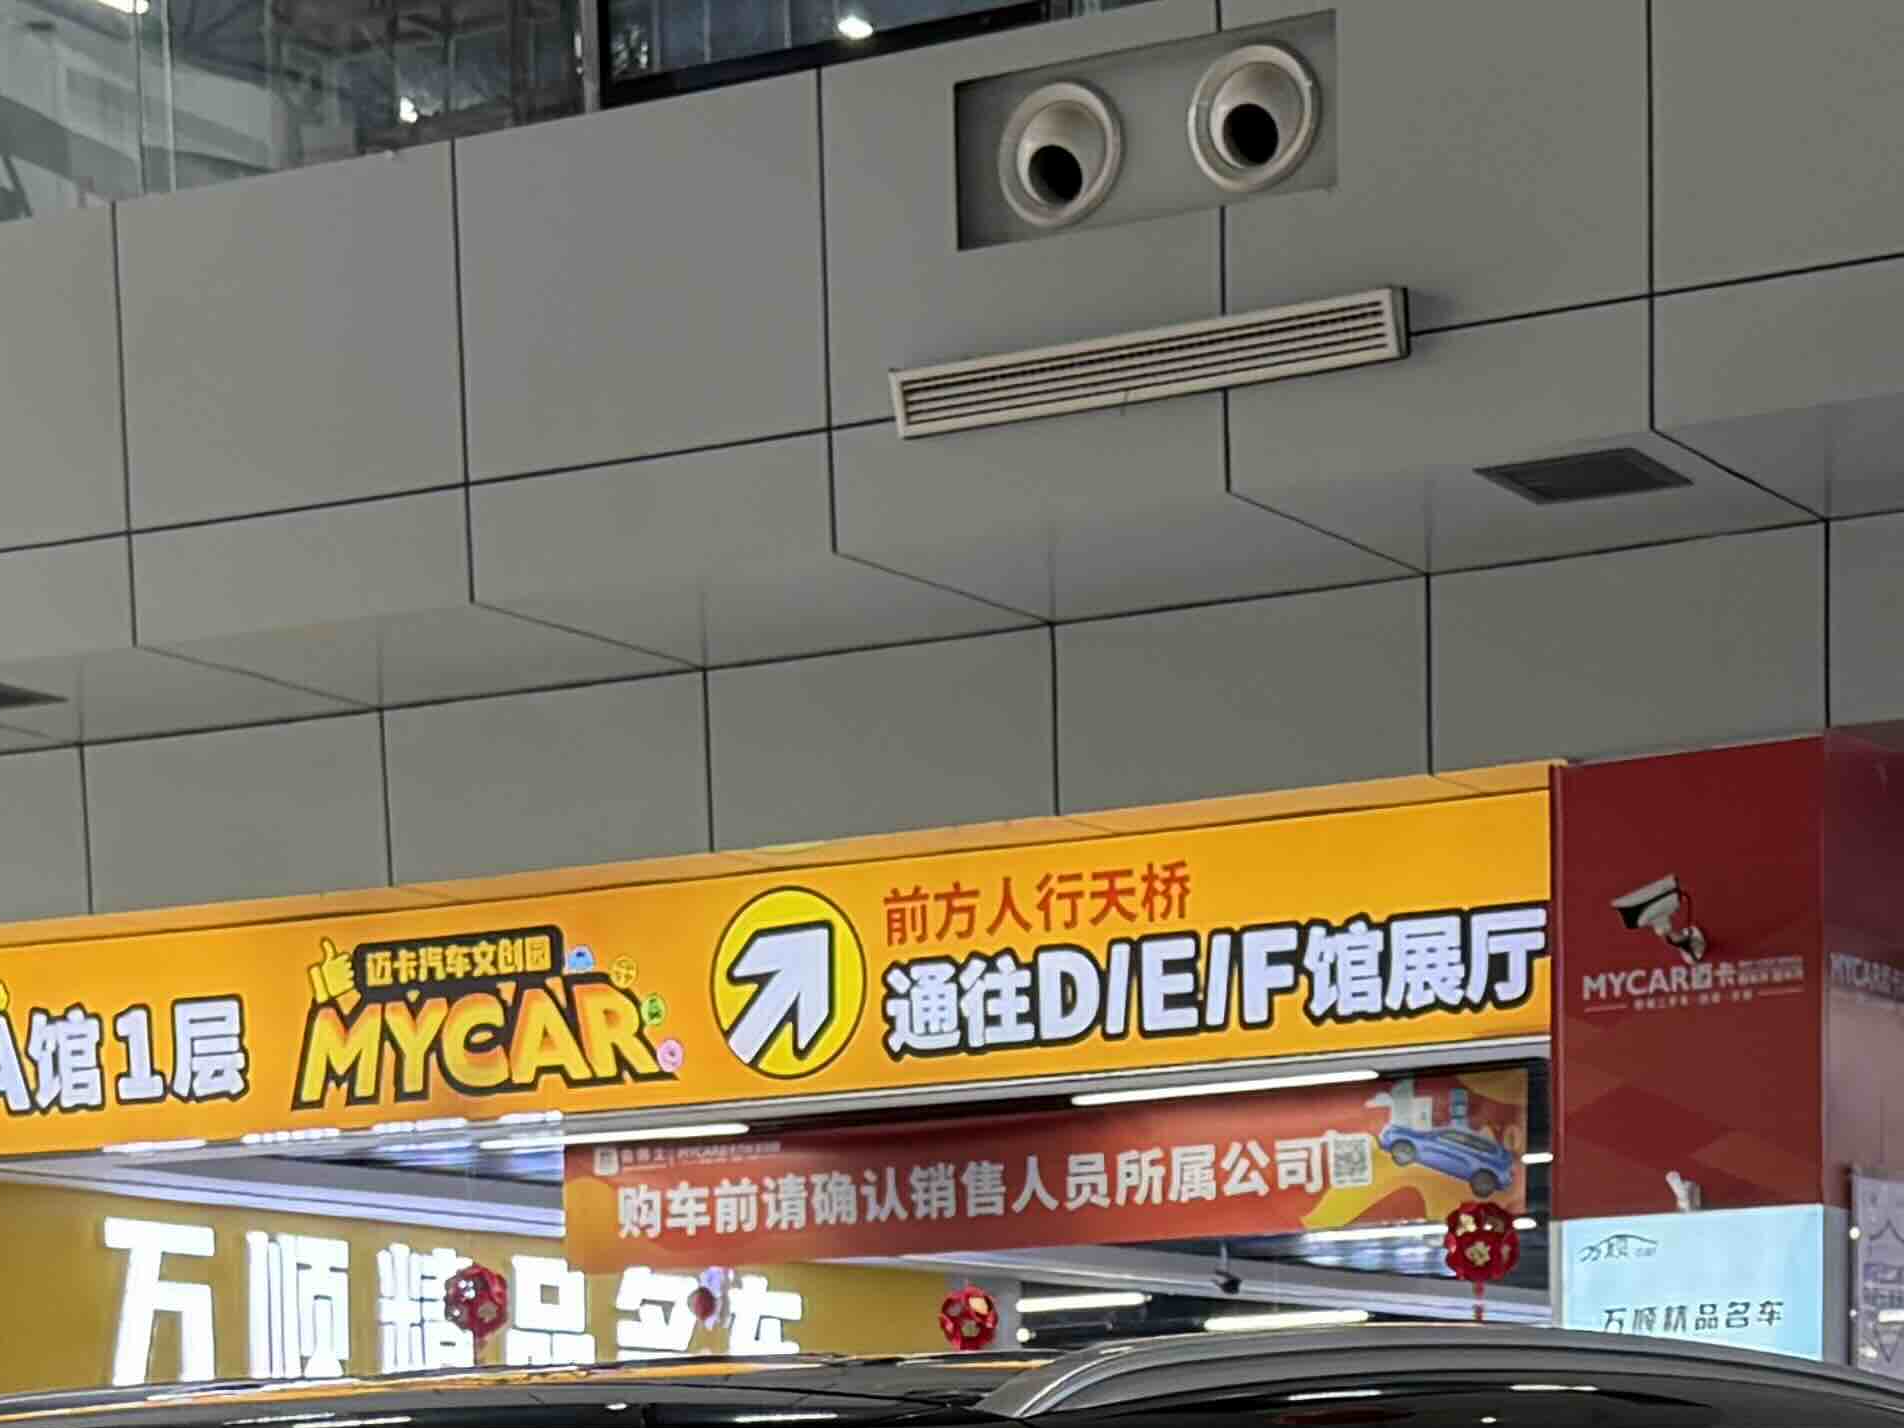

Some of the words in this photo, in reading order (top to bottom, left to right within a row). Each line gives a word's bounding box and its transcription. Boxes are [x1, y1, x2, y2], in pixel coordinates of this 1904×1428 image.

[883, 861, 1192, 947] 前方人行天桥
[364, 936, 552, 988] 迈卡汽车文创园
[883, 906, 1548, 1056] 通往D/E/F馆展厅
[299, 978, 664, 1106] MYCAR
[617, 1139, 1328, 1239] 购车前请确认销售人员所属公司
[1602, 1300, 1785, 1333] 万顺精品名车
